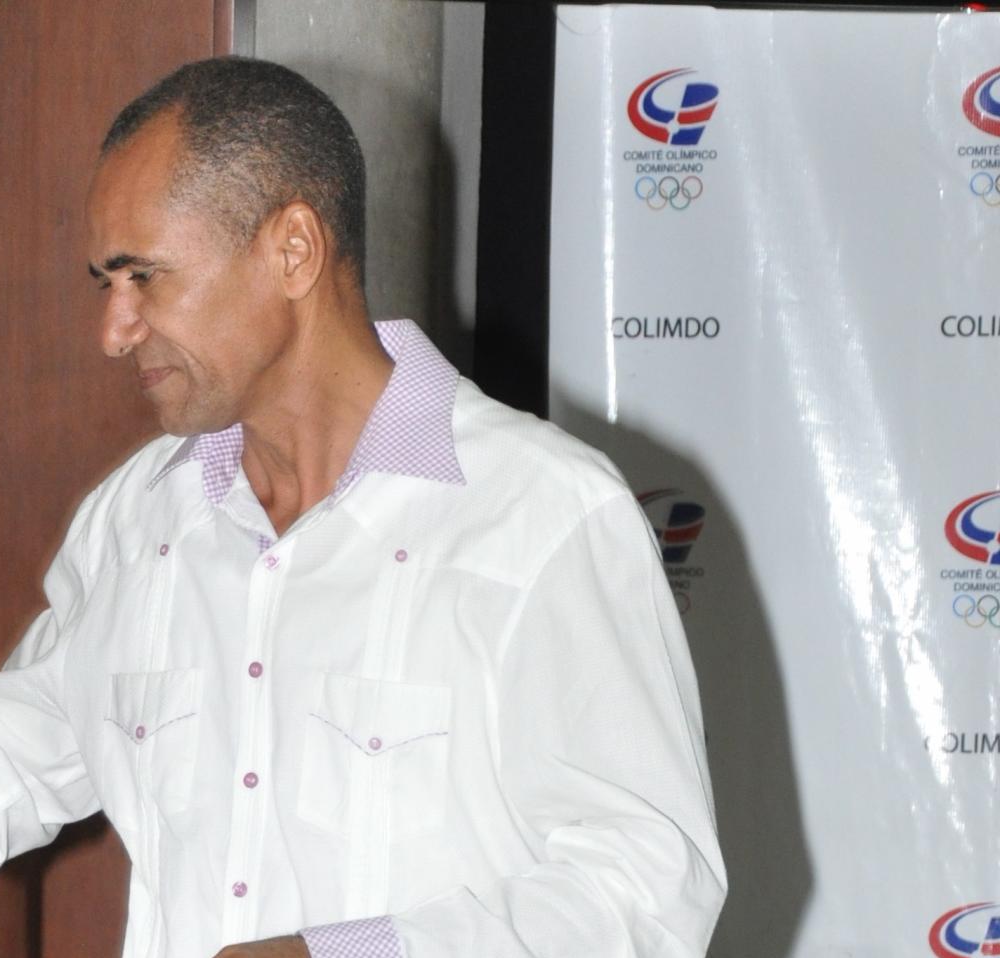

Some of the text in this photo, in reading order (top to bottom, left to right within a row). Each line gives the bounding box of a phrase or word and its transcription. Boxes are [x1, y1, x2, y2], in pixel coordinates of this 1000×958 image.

[623, 148, 718, 161] COMITÉ OLÍMPICO
[636, 163, 704, 174] DOMINICANO
[612, 316, 720, 338] COLIMDO
[940, 315, 1000, 338] COLI
[940, 568, 982, 579] COMITÉ
